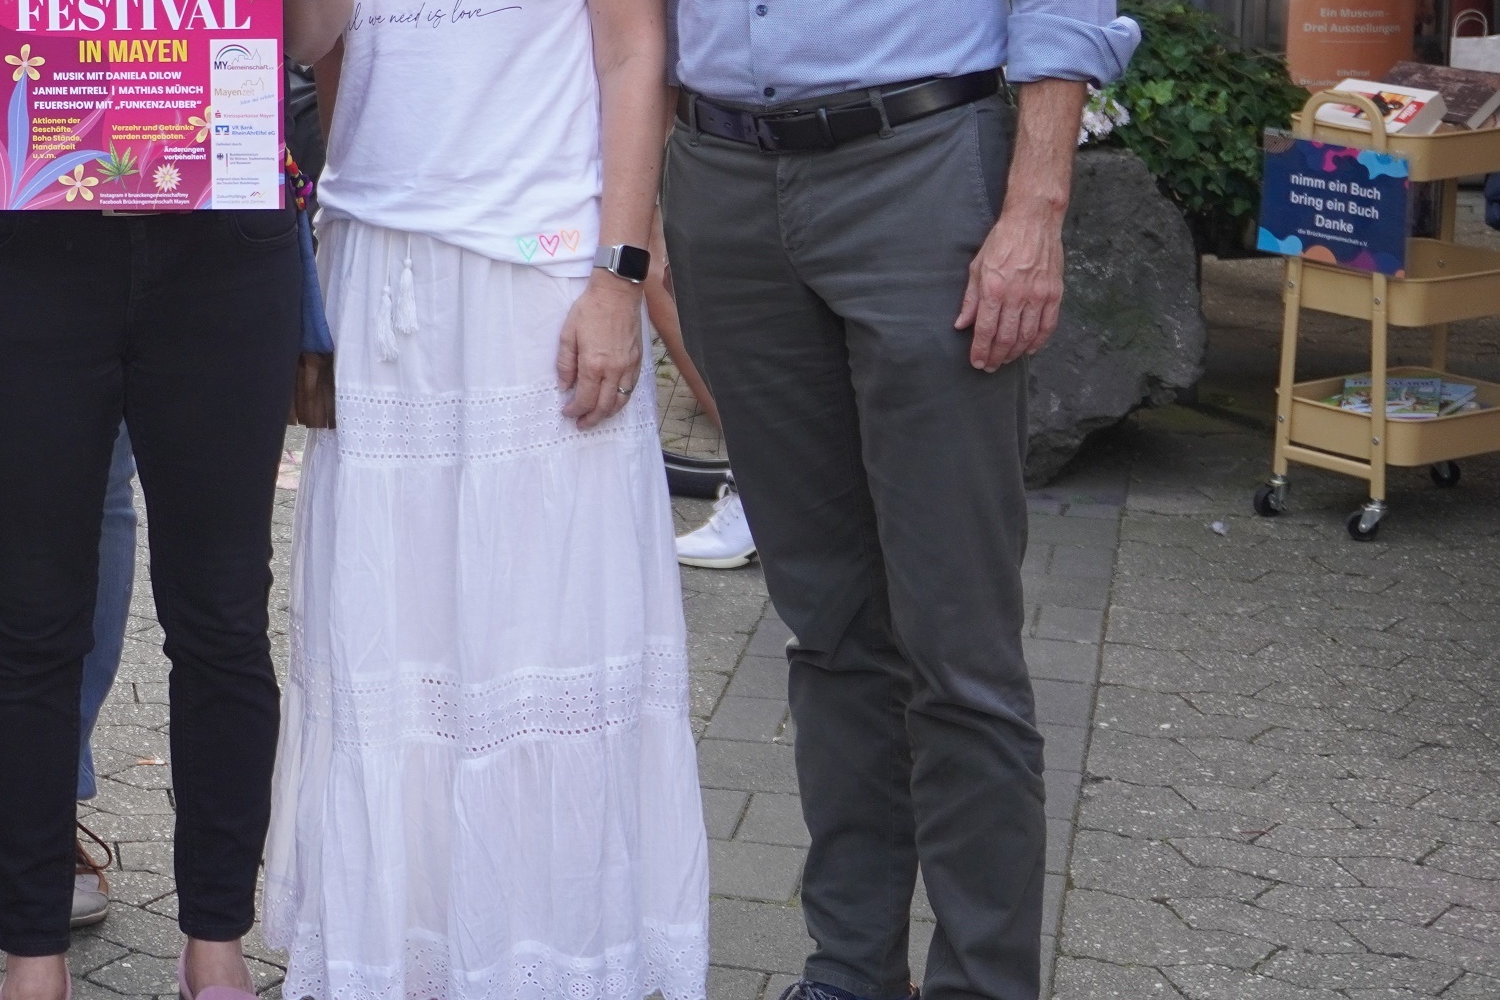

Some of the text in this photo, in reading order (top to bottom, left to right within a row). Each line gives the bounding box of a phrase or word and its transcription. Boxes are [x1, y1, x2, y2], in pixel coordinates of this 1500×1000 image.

[368, 15, 386, 26] we
[389, 2, 426, 28] need
[427, 8, 446, 29] is
[1320, 8, 1338, 18] Ein
[1340, 8, 1384, 18] Museum
[1303, 23, 1401, 36] Drei Ausstellungen
[78, 39, 189, 63] IN MAYEN
[53, 70, 182, 81] MUSIK MIT DANIELA DILOW
[32, 86, 68, 96] JANINE
[69, 86, 108, 96] MITRELL
[118, 86, 164, 95] MATHIAS
[166, 84, 204, 95] MÜNCH
[33, 100, 94, 110] FEUERSHOW
[95, 100, 113, 110] MIT
[32, 126, 73, 134] Geschäfte,
[112, 124, 195, 132] Verzehr und Getränke
[53, 135, 82, 143] Stände,
[142, 133, 186, 142] angeboten.
[32, 143, 76, 151] Handarbeit
[164, 145, 205, 154] Änderungen
[1290, 173, 1381, 201] nimm ein Buch
[100, 192, 124, 200] Instagram
[1290, 190, 1379, 220] bring ein Buch
[1315, 214, 1354, 234] Danke
